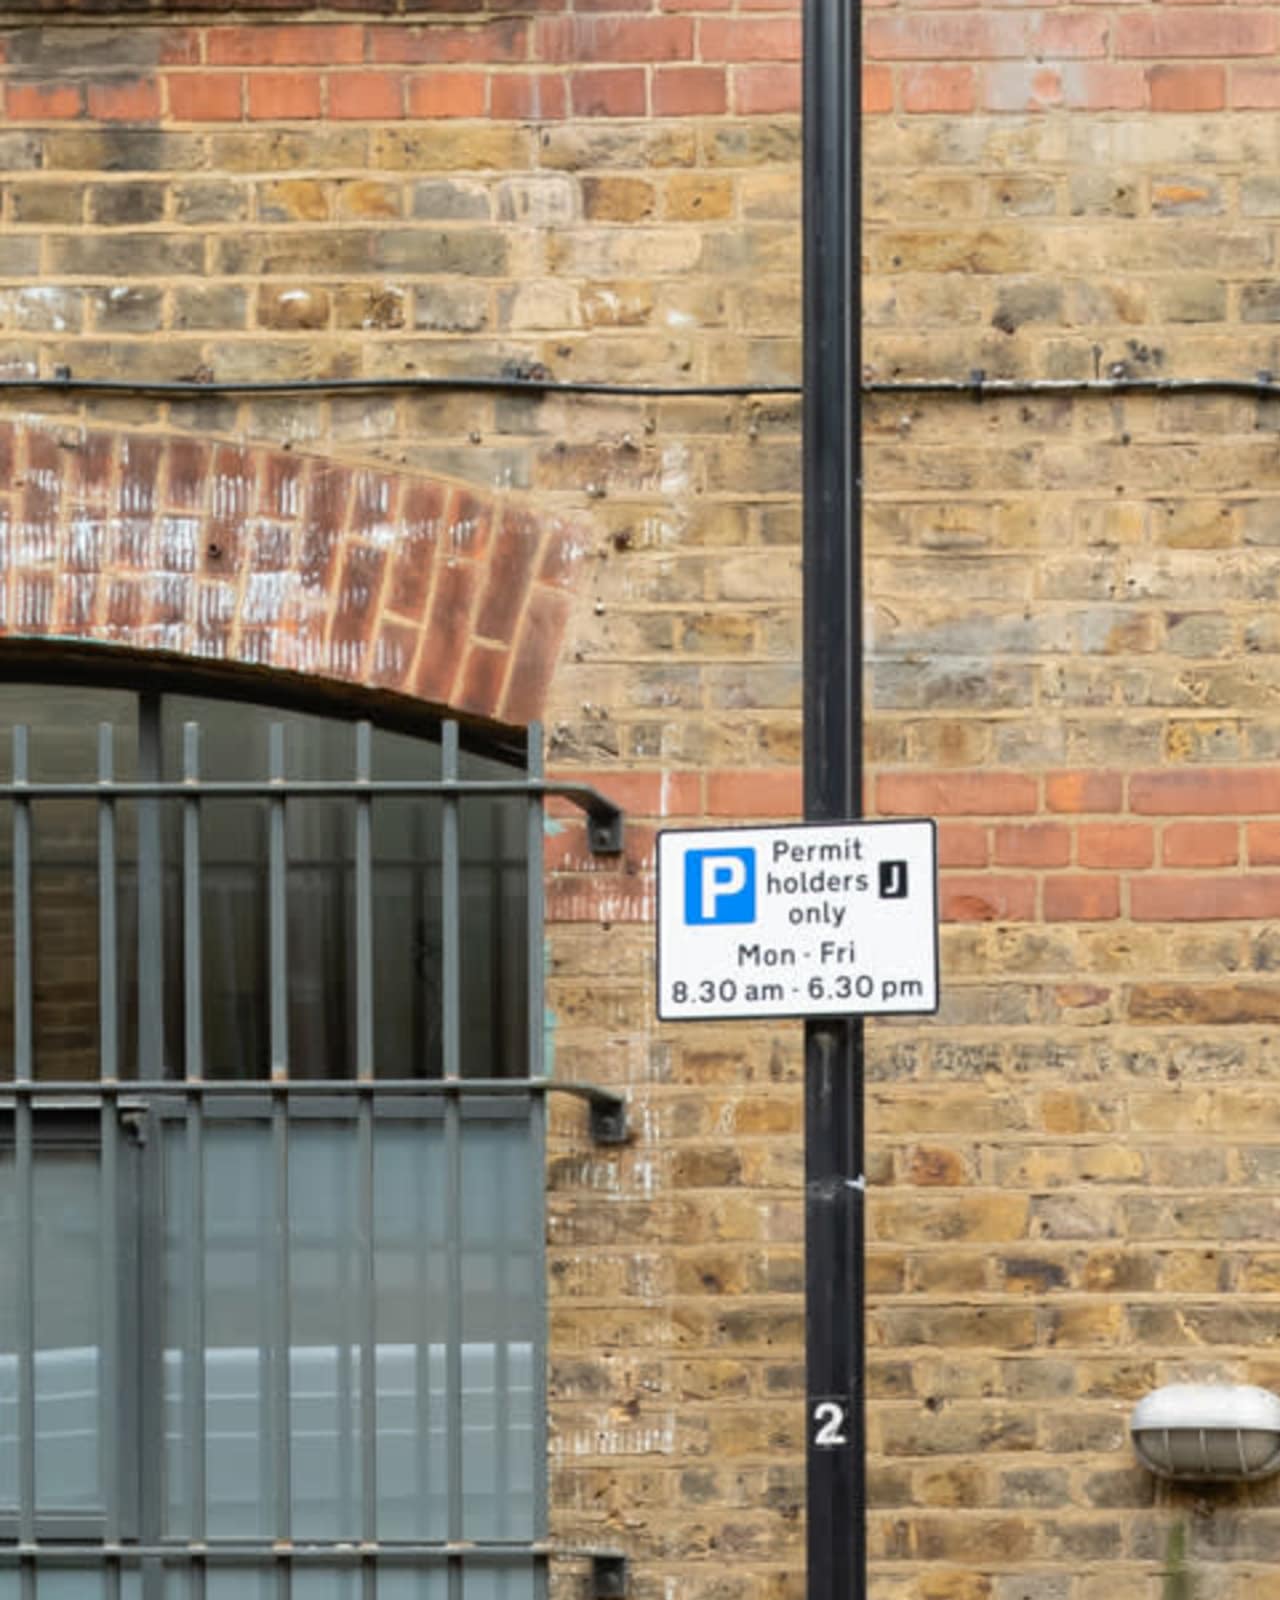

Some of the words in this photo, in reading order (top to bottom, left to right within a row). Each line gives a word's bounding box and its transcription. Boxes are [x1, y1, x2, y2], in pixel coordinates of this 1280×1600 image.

[772, 838, 863, 863] Permit
[702, 856, 746, 919] P
[766, 871, 869, 895] holders
[884, 864, 900, 895] J
[788, 901, 846, 928] only
[737, 943, 796, 967] Mon
[820, 940, 855, 965] Fri
[671, 979, 738, 1004] 8.30
[744, 984, 785, 1002] am
[807, 974, 875, 1001] 6.30
[881, 978, 924, 1002] pm
[814, 1402, 846, 1445] 2
